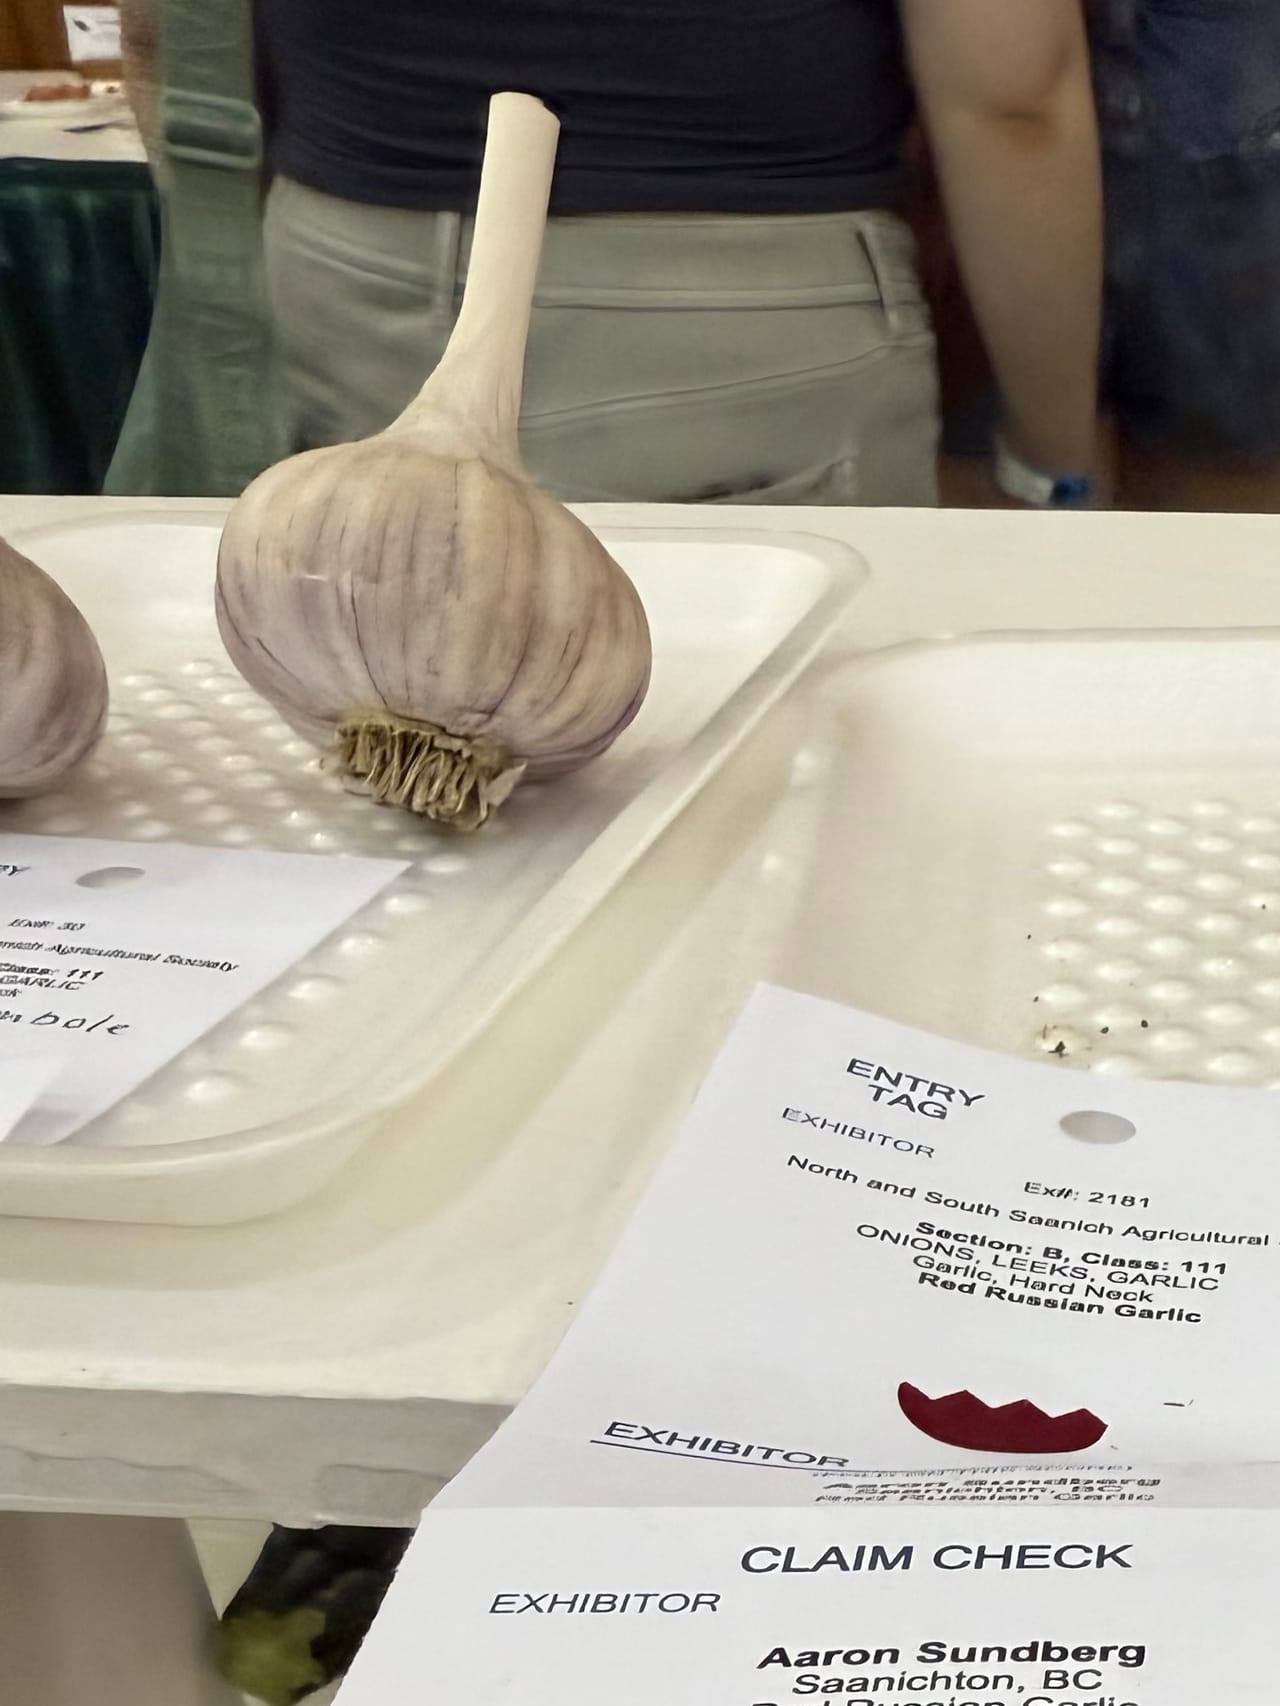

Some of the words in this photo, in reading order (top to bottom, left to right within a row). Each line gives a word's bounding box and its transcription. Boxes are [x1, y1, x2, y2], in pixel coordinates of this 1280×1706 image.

[67, 968, 104, 981] 111
[847, 1058, 985, 1107] ENTRY
[868, 1084, 947, 1120] TAG
[782, 1107, 935, 1158] EXHIBITOR
[787, 1155, 859, 1184] North
[867, 1178, 917, 1199] and
[924, 1191, 1000, 1218] South
[1008, 1209, 1113, 1236] Saanich
[1121, 1226, 1269, 1247] Agricultural
[1088, 1191, 1151, 1209] 2181
[856, 1224, 981, 1264] ONIONS,
[992, 1254, 1095, 1283] LEEKS,
[1107, 1271, 1219, 1291] GARLIC
[916, 1222, 1032, 1256] Section:
[1043, 1247, 1070, 1263] B,
[1081, 1252, 1169, 1271] Class:
[1181, 1261, 1227, 1275] 111
[913, 1255, 998, 1285] Garlic,
[1009, 1273, 1075, 1295] Hard
[1085, 1284, 1154, 1303] Neck
[918, 1272, 976, 1295] Red
[984, 1286, 1104, 1315] Russian
[1114, 1304, 1202, 1324] Garlic
[604, 1421, 849, 1467] EXHIBITOR
[741, 1545, 914, 1573] CLAIM
[933, 1544, 1133, 1570] CHECK
[489, 1593, 721, 1613] EXHIBITOR
[757, 1647, 900, 1669] Aaron
[916, 1641, 1146, 1668] Sundberg
[793, 1670, 1025, 1695] Saanichton,
[1042, 1669, 1103, 1690] BC
